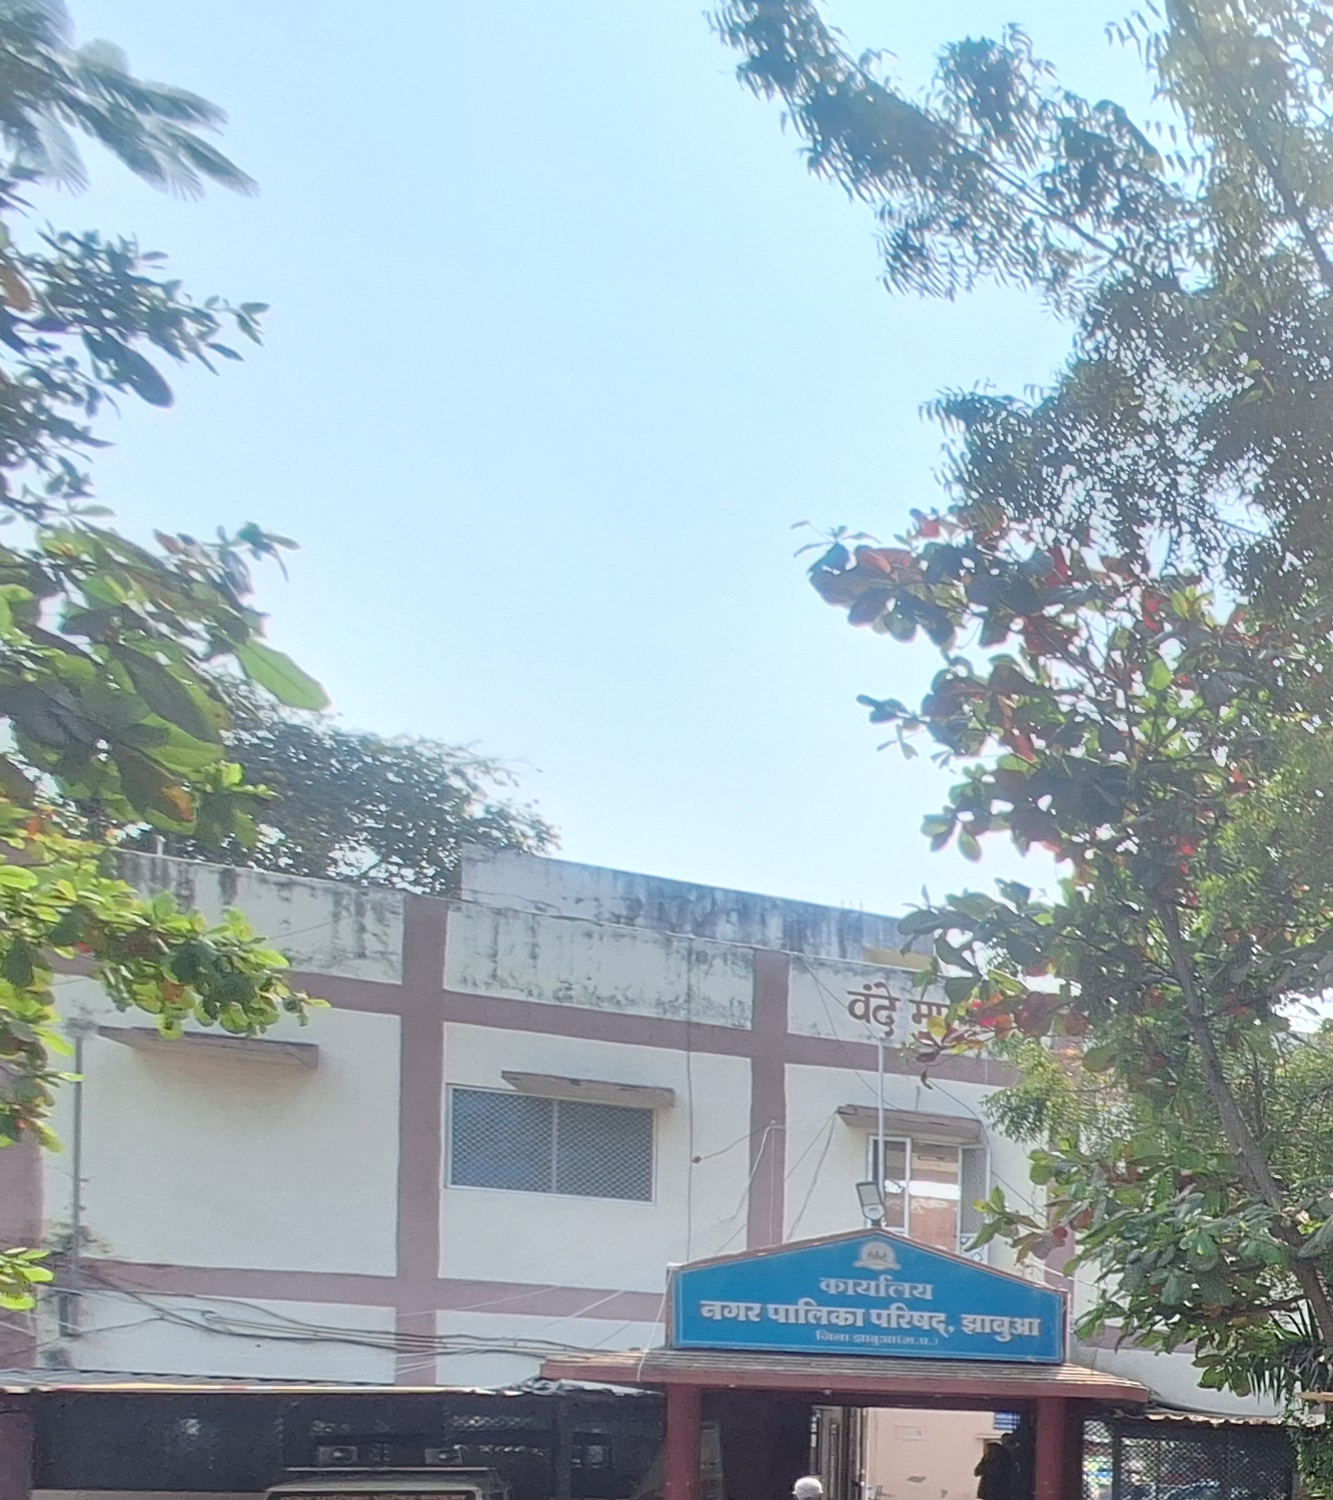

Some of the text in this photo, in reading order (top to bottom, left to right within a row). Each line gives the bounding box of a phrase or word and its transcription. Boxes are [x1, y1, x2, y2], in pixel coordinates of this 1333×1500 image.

[846, 981, 901, 1037] वंदे
[819, 1275, 934, 1300] कार्यालय
[700, 1300, 761, 1322] नगर
[766, 1298, 865, 1326] पालिका
[961, 1314, 1041, 1342] झाबुआ
